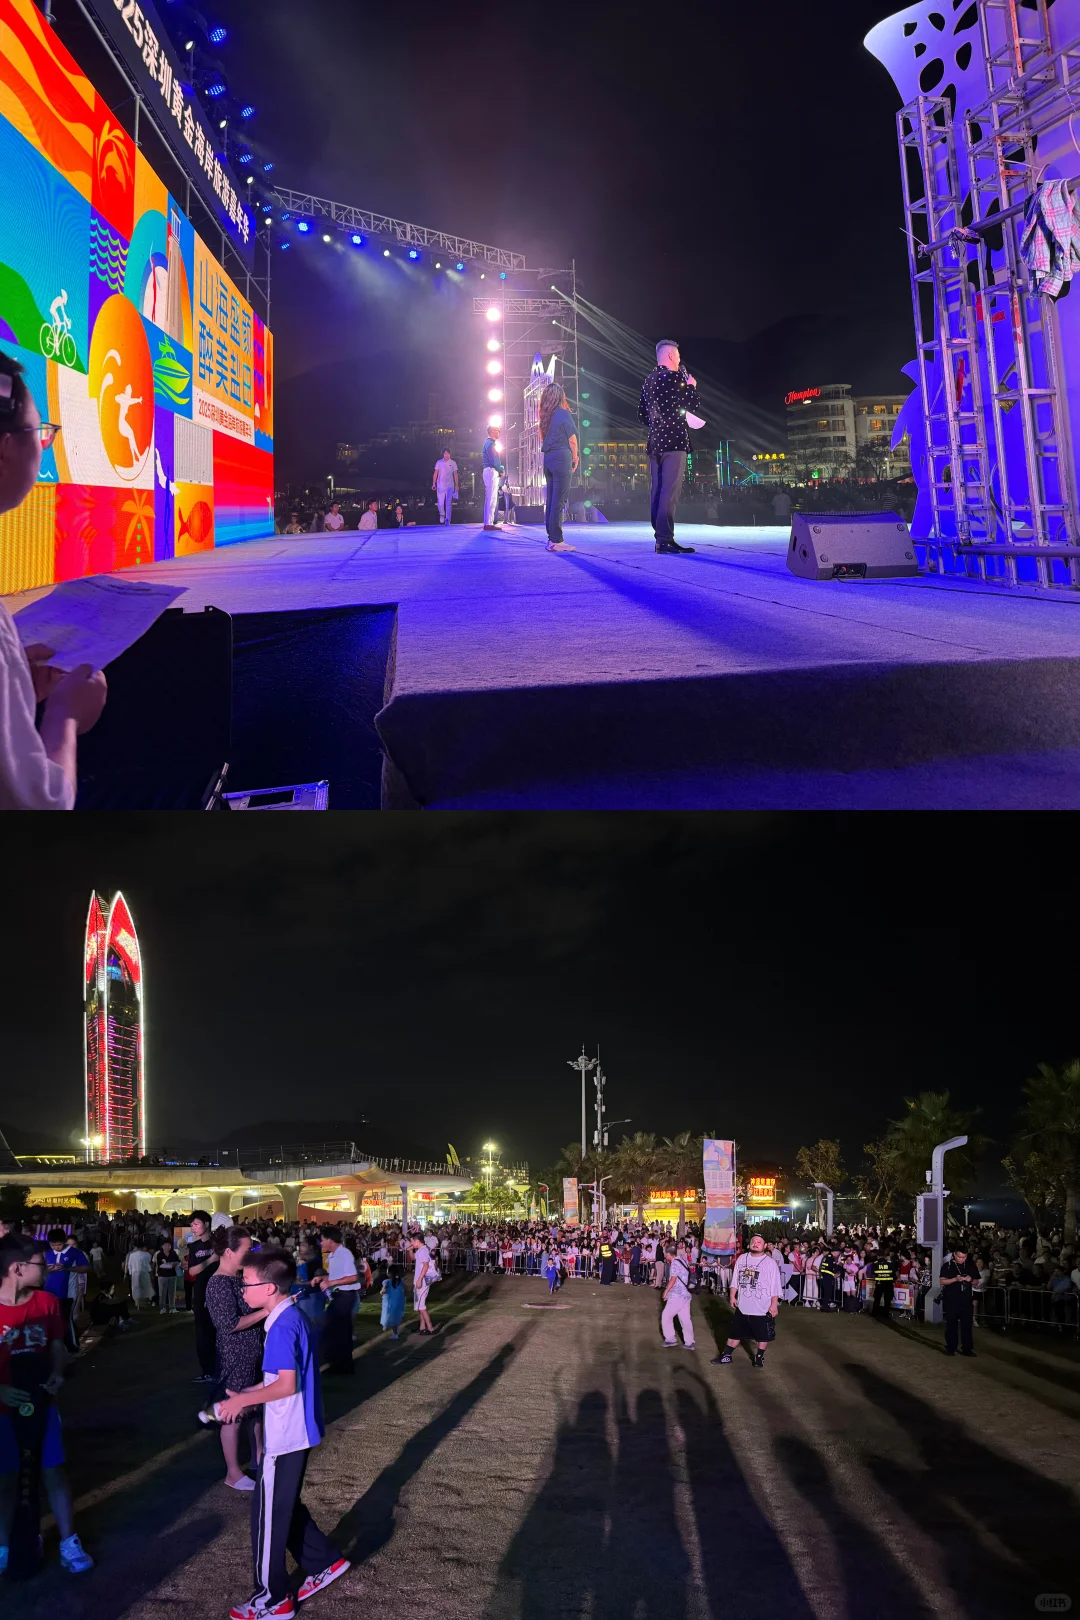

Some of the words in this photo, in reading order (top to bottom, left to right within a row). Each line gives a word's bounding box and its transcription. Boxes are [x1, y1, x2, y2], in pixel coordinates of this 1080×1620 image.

[113, 0, 249, 244] 25深圳黄金海岸旅游嘉年华
[199, 258, 252, 360] 山海盛颜
[199, 321, 252, 409] 醉美盐田
